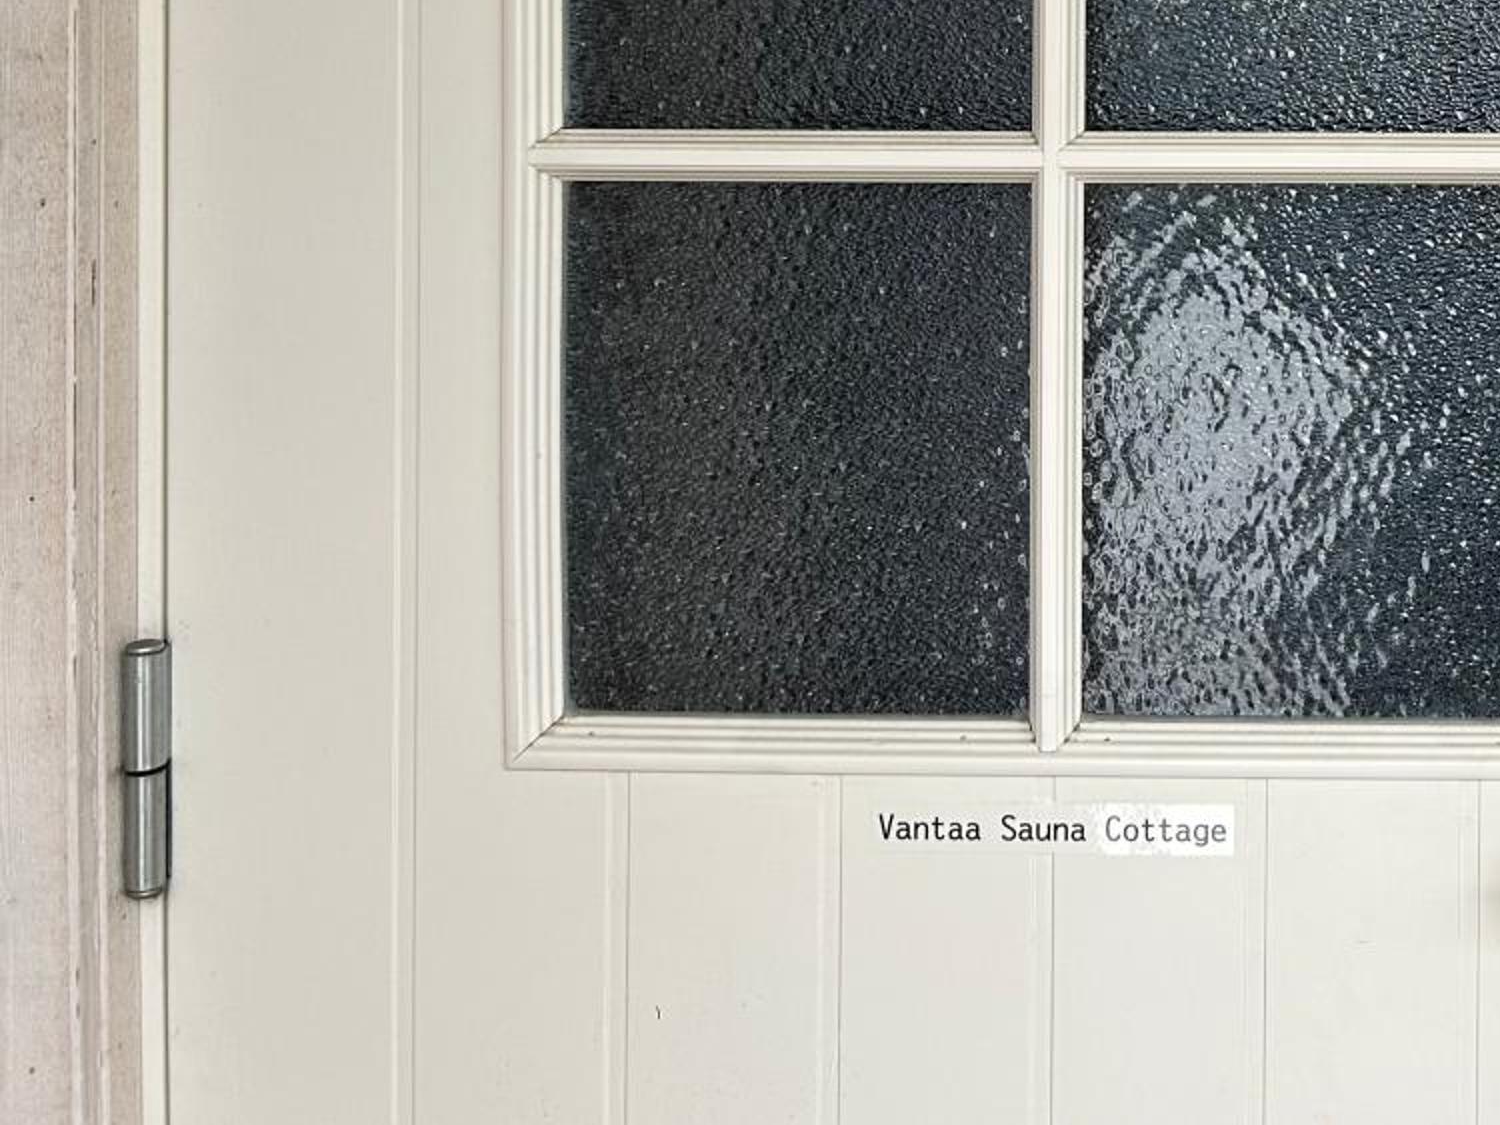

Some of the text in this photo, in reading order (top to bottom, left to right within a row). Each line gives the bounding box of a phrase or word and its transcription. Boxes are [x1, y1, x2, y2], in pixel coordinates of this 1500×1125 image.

[879, 813, 1228, 848] Vantaa Sauna Cottage
